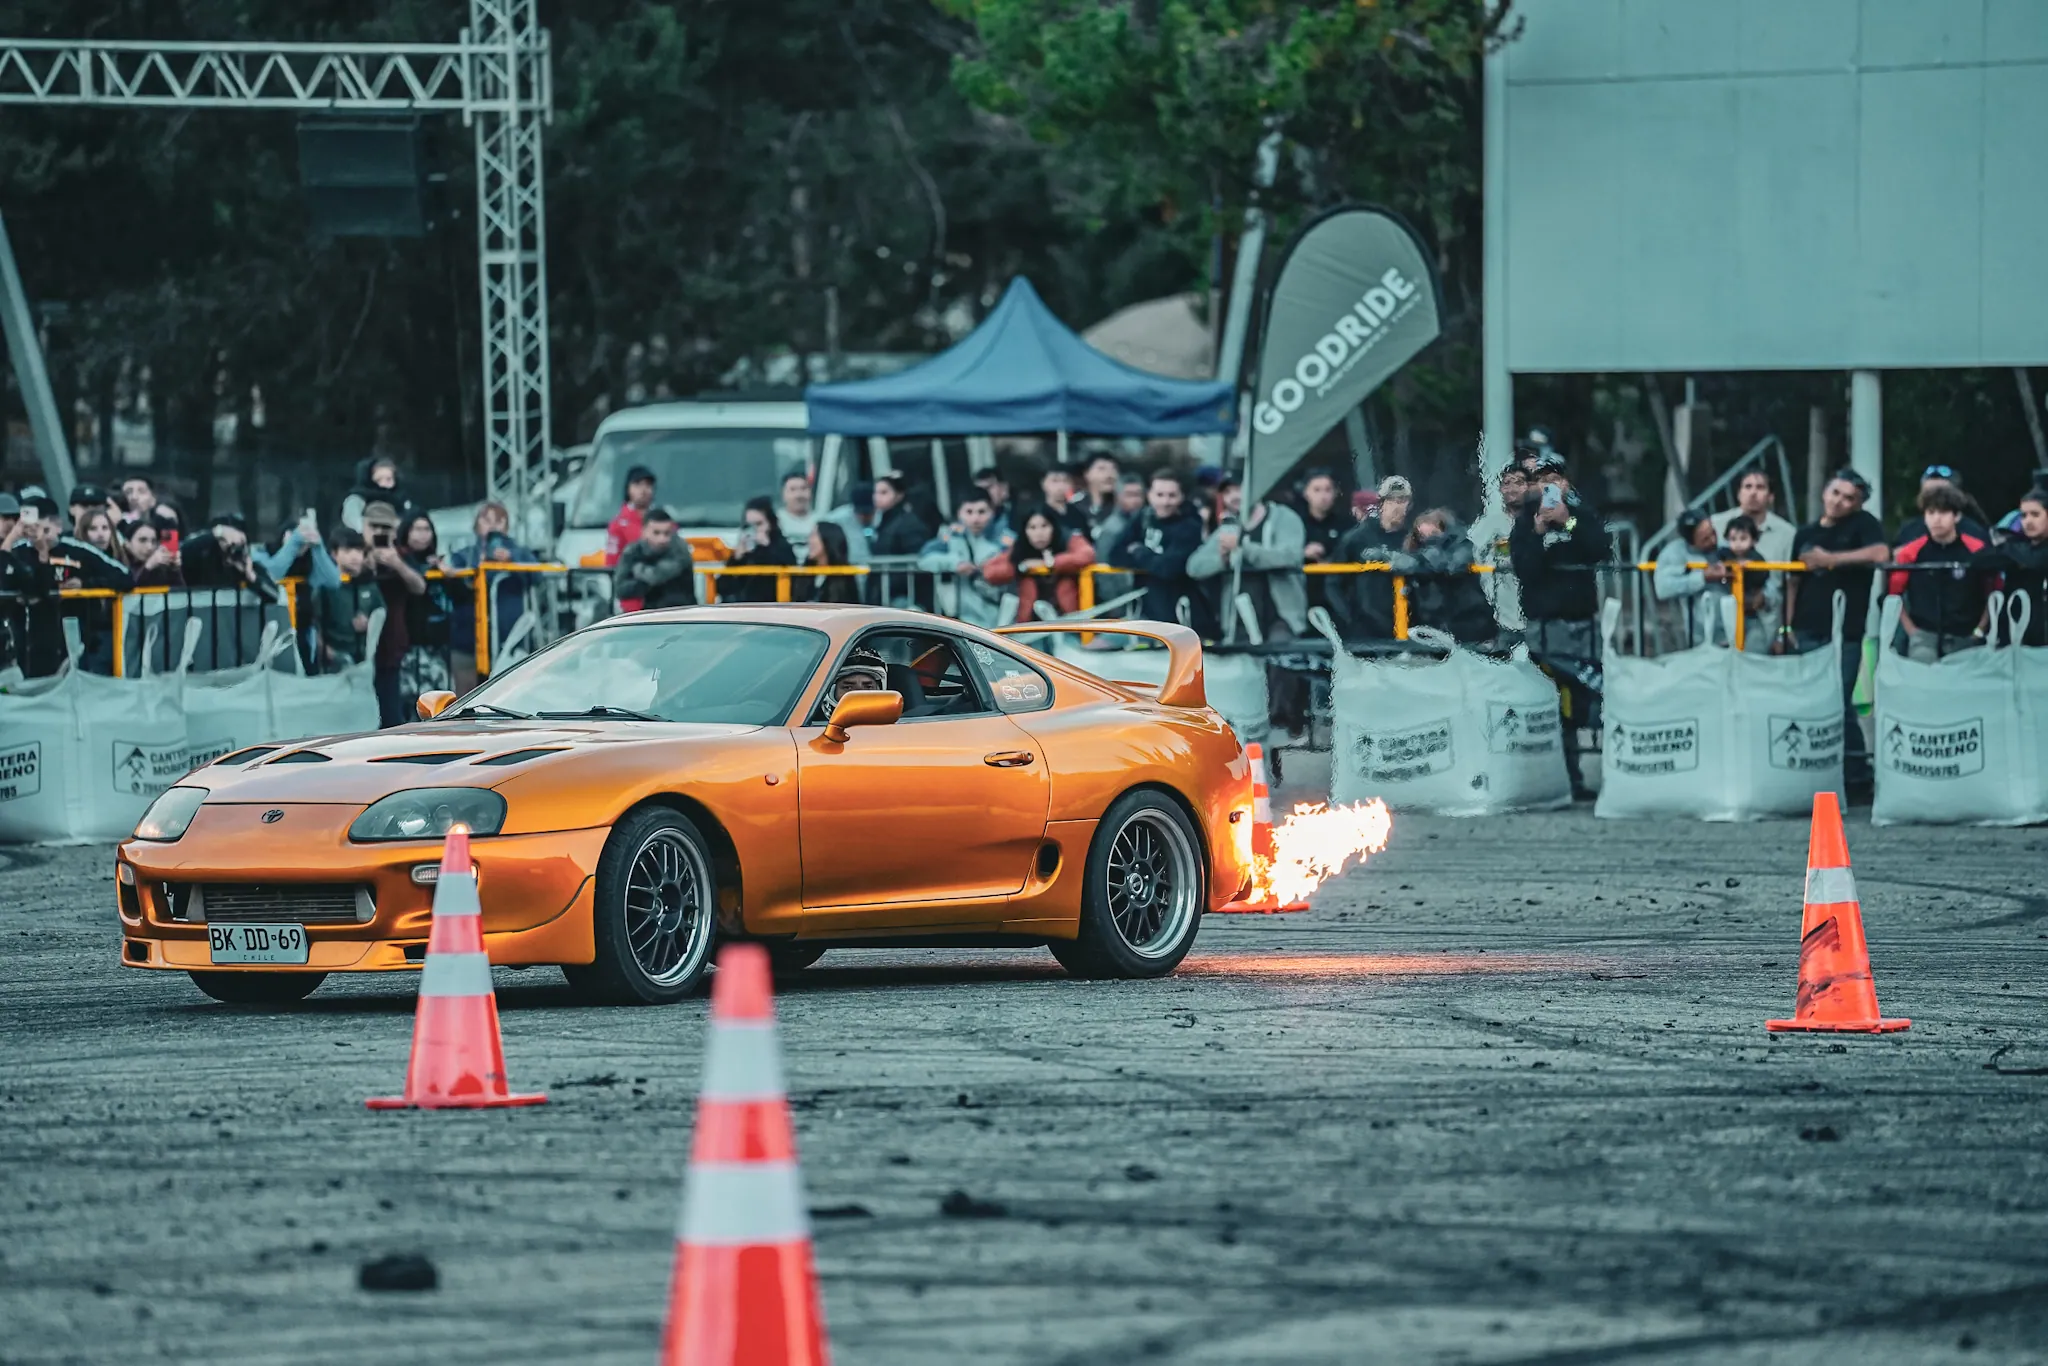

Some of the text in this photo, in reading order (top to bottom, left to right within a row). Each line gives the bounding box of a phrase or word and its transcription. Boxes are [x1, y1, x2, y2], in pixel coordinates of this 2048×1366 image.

[1253, 267, 1416, 434] GOODRIDE
[1909, 728, 1979, 745] CANTERA
[1912, 741, 1978, 759] MORENO
